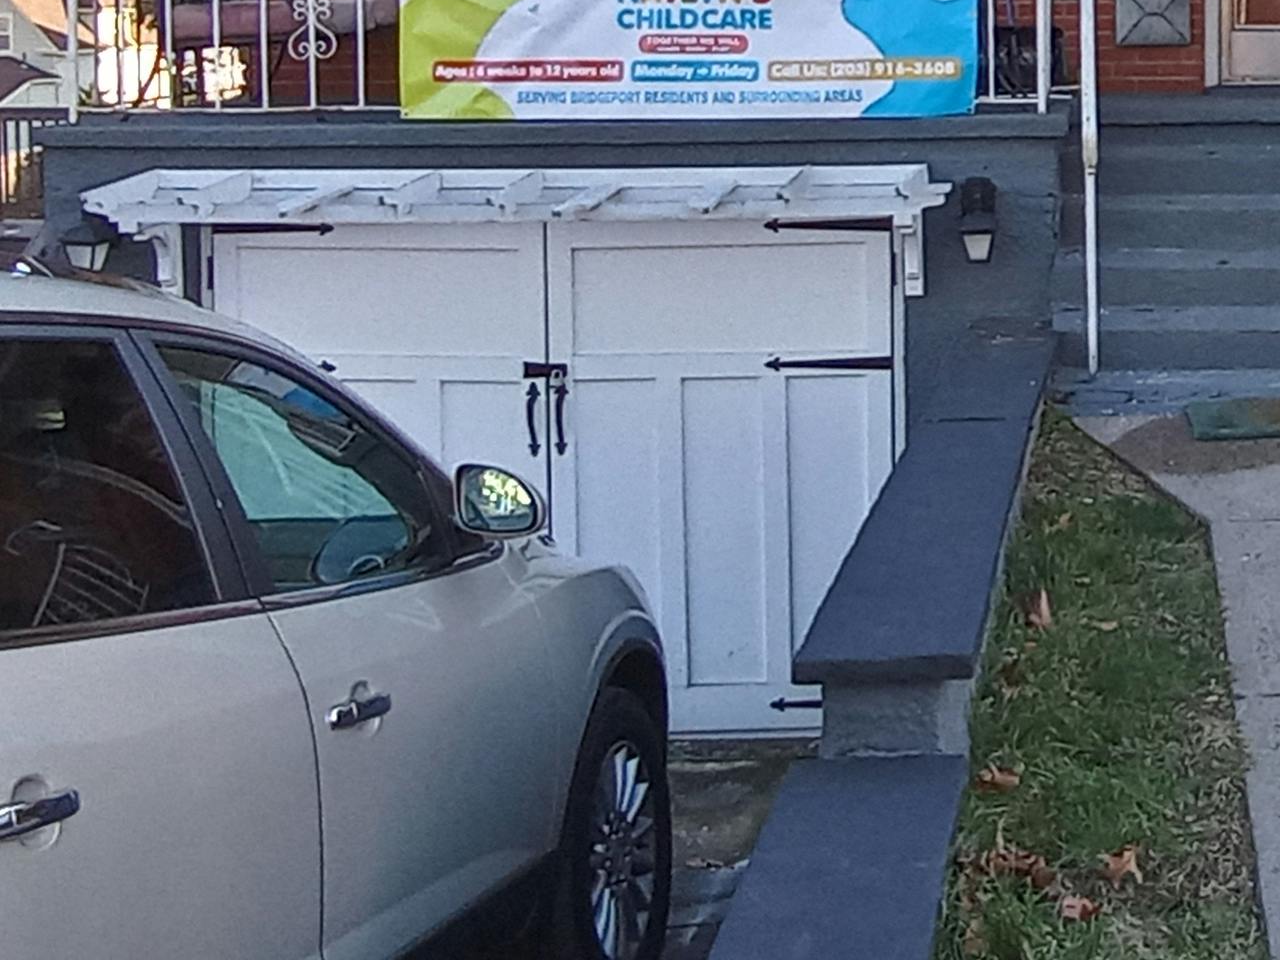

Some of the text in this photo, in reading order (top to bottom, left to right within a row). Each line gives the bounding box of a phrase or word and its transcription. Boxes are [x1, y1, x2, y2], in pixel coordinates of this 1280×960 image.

[617, 8, 772, 29] CHILDCARE
[487, 65, 527, 77] weeks
[545, 65, 560, 77] 12
[562, 66, 598, 79] years
[600, 64, 620, 77] old
[635, 64, 694, 80] Monday
[711, 63, 755, 80] Friday
[771, 63, 800, 77] Call
[831, 61, 870, 77] (203)
[517, 91, 567, 103] SERVING
[644, 91, 708, 103] RESIDENTS
[712, 91, 735, 103] AND
[823, 89, 863, 102] AREAS
